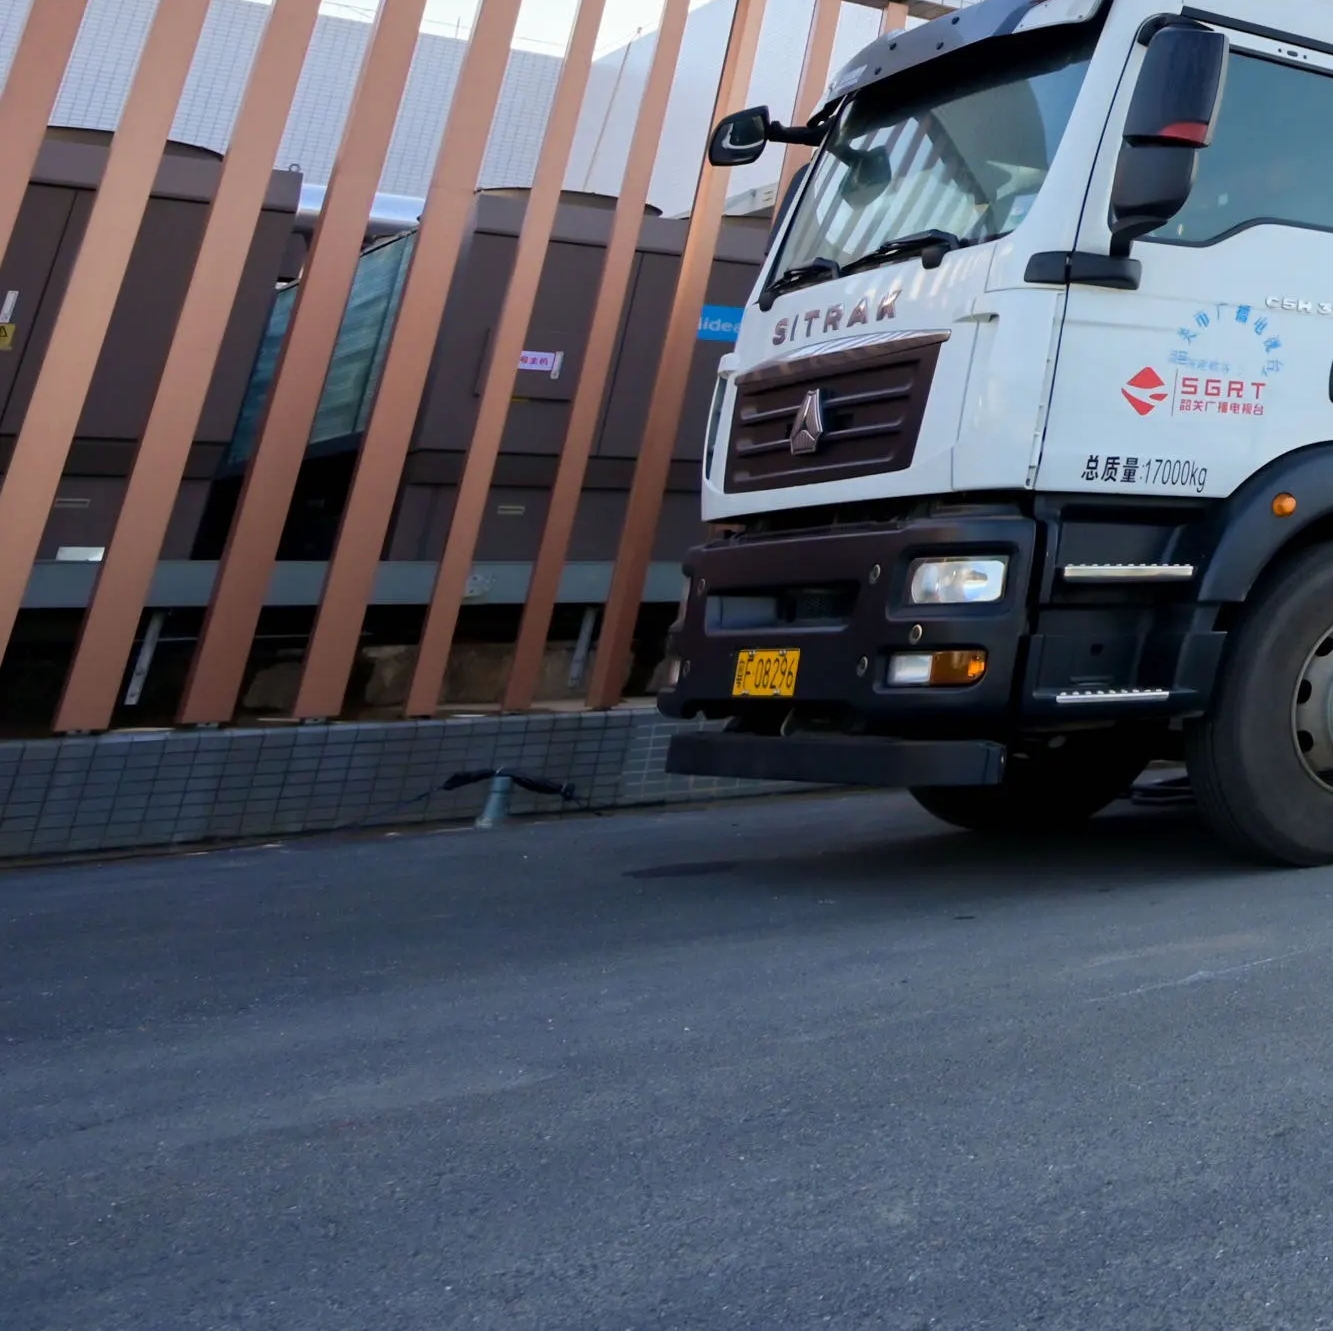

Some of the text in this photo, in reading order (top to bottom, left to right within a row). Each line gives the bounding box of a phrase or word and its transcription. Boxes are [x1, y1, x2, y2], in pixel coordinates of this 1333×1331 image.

[1264, 295, 1313, 314] C5H
[772, 289, 902, 346] SITRAK
[1181, 376, 1266, 400] SGRT
[1179, 398, 1264, 416] 韶关广播电视台
